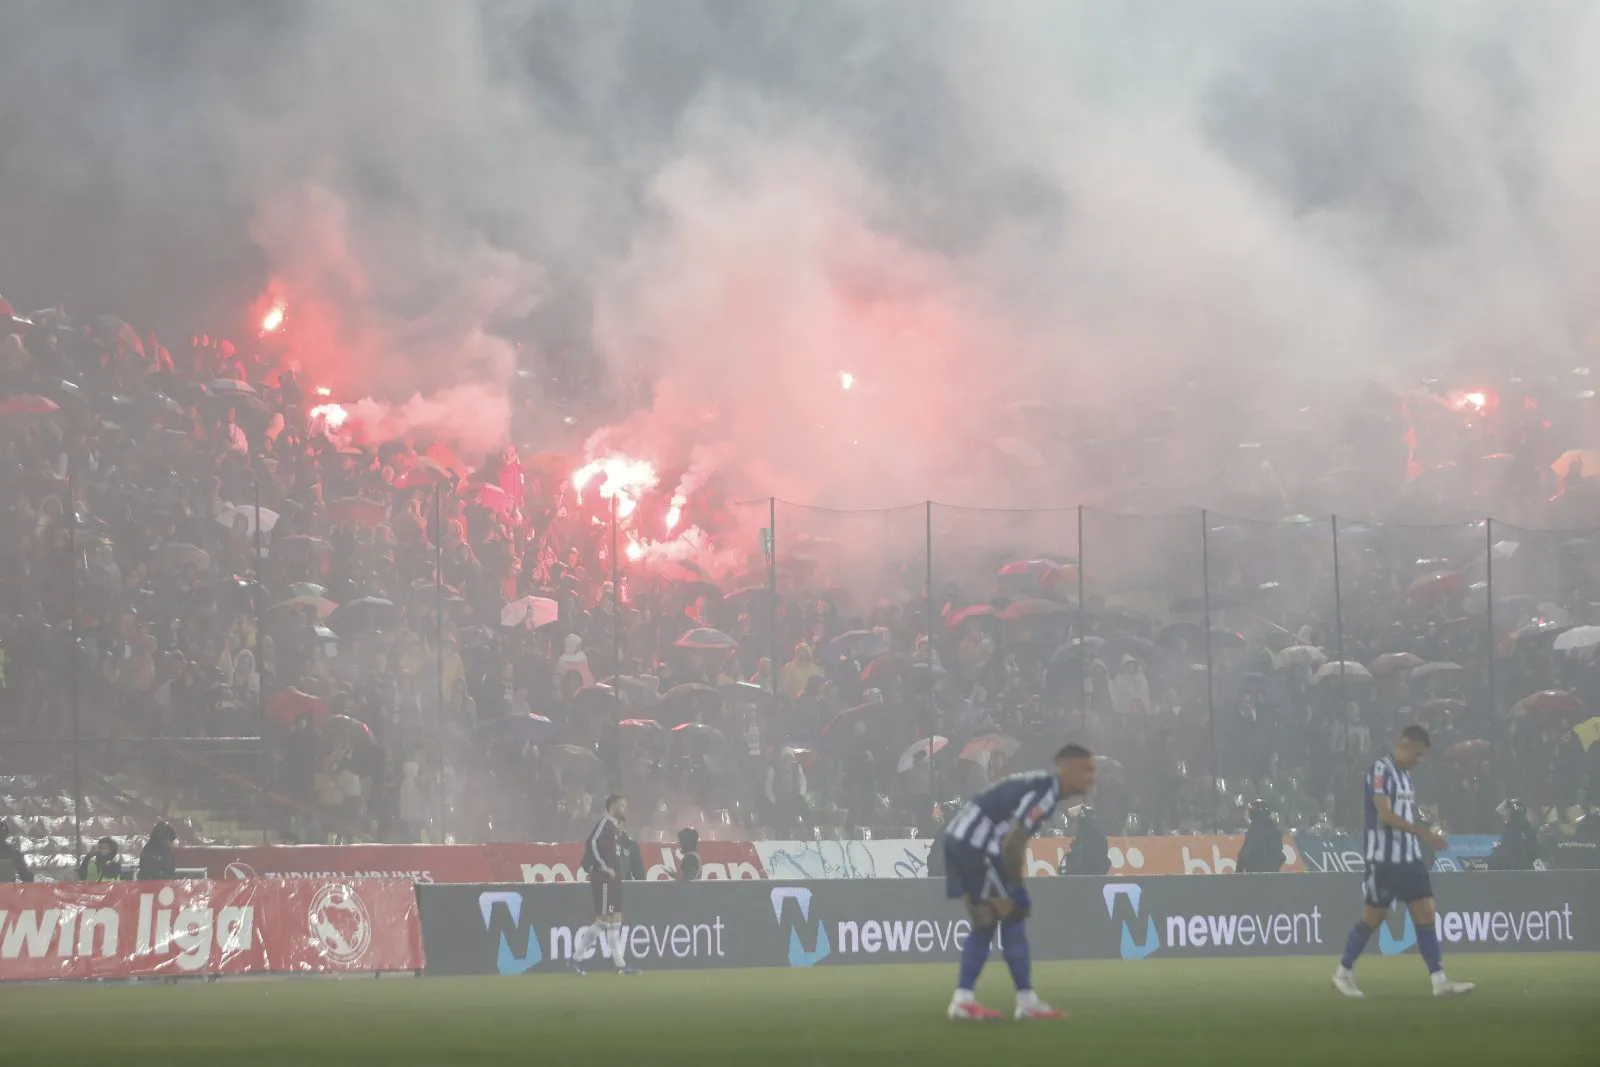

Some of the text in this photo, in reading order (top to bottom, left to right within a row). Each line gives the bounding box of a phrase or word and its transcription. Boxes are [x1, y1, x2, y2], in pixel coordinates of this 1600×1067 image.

[0, 907, 120, 958] win
[136, 886, 254, 970] liga
[1166, 904, 1323, 947] newevent
